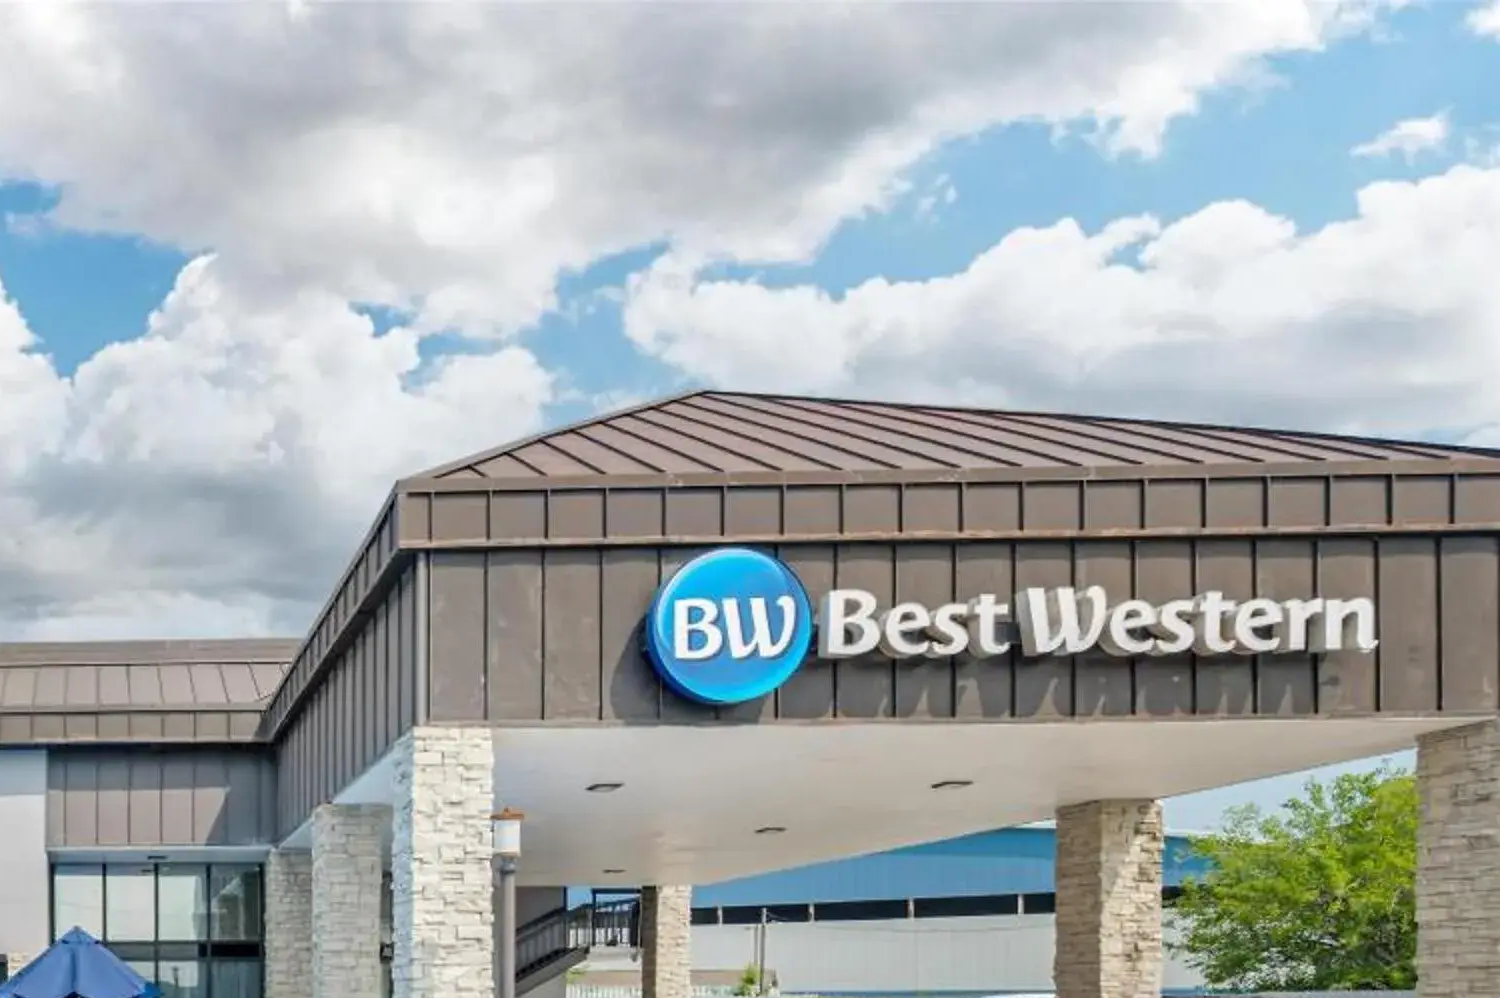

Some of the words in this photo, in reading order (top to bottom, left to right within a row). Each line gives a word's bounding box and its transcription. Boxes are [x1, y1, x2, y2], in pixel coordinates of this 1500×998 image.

[674, 594, 797, 660] BW
[825, 588, 1011, 656] Best
[1023, 585, 1380, 655] Western
